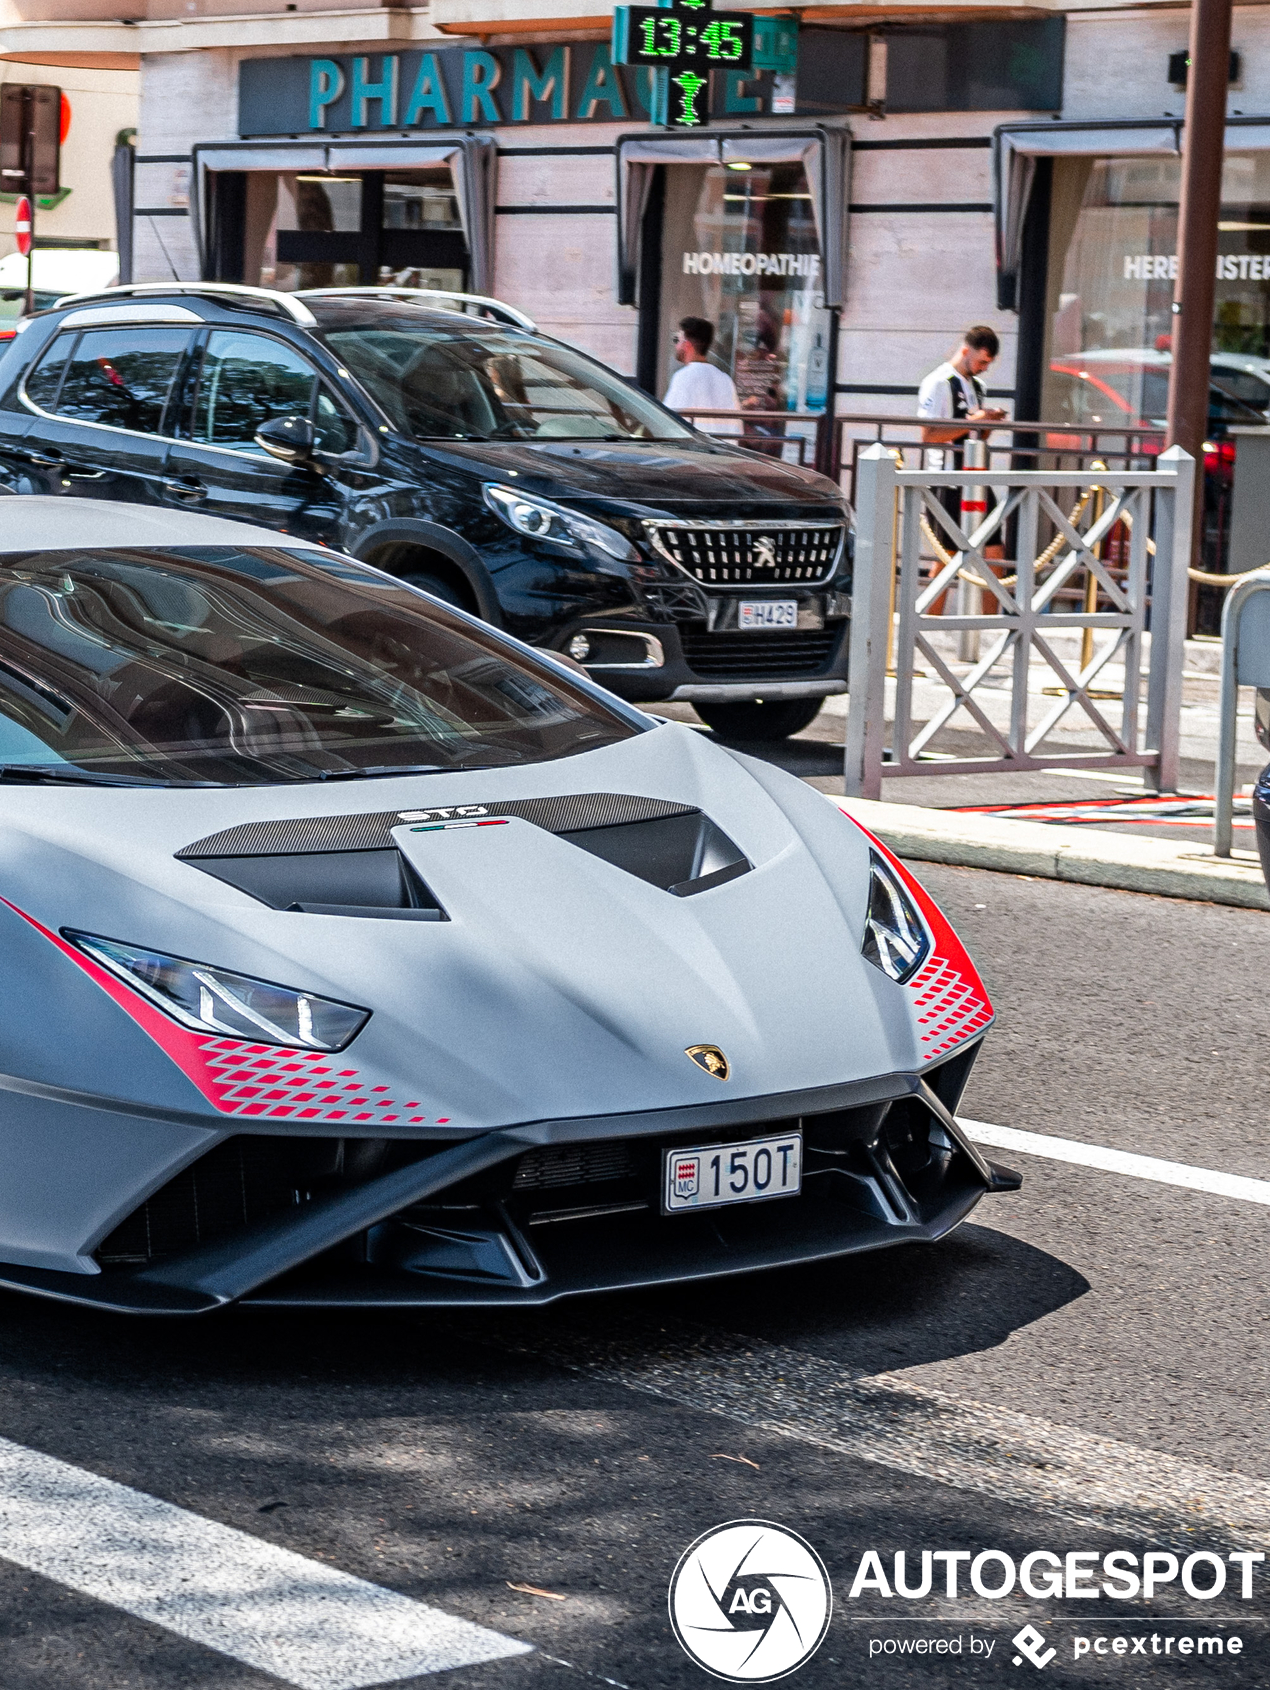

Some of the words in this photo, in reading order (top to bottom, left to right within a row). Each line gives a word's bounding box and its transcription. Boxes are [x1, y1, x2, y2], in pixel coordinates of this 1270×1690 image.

[639, 16, 744, 61] 13:45
[308, 43, 764, 129] PHARMAE
[683, 252, 821, 276] HOMEOPATHIE
[397, 805, 488, 822] STO
[711, 1144, 794, 1196] 150T
